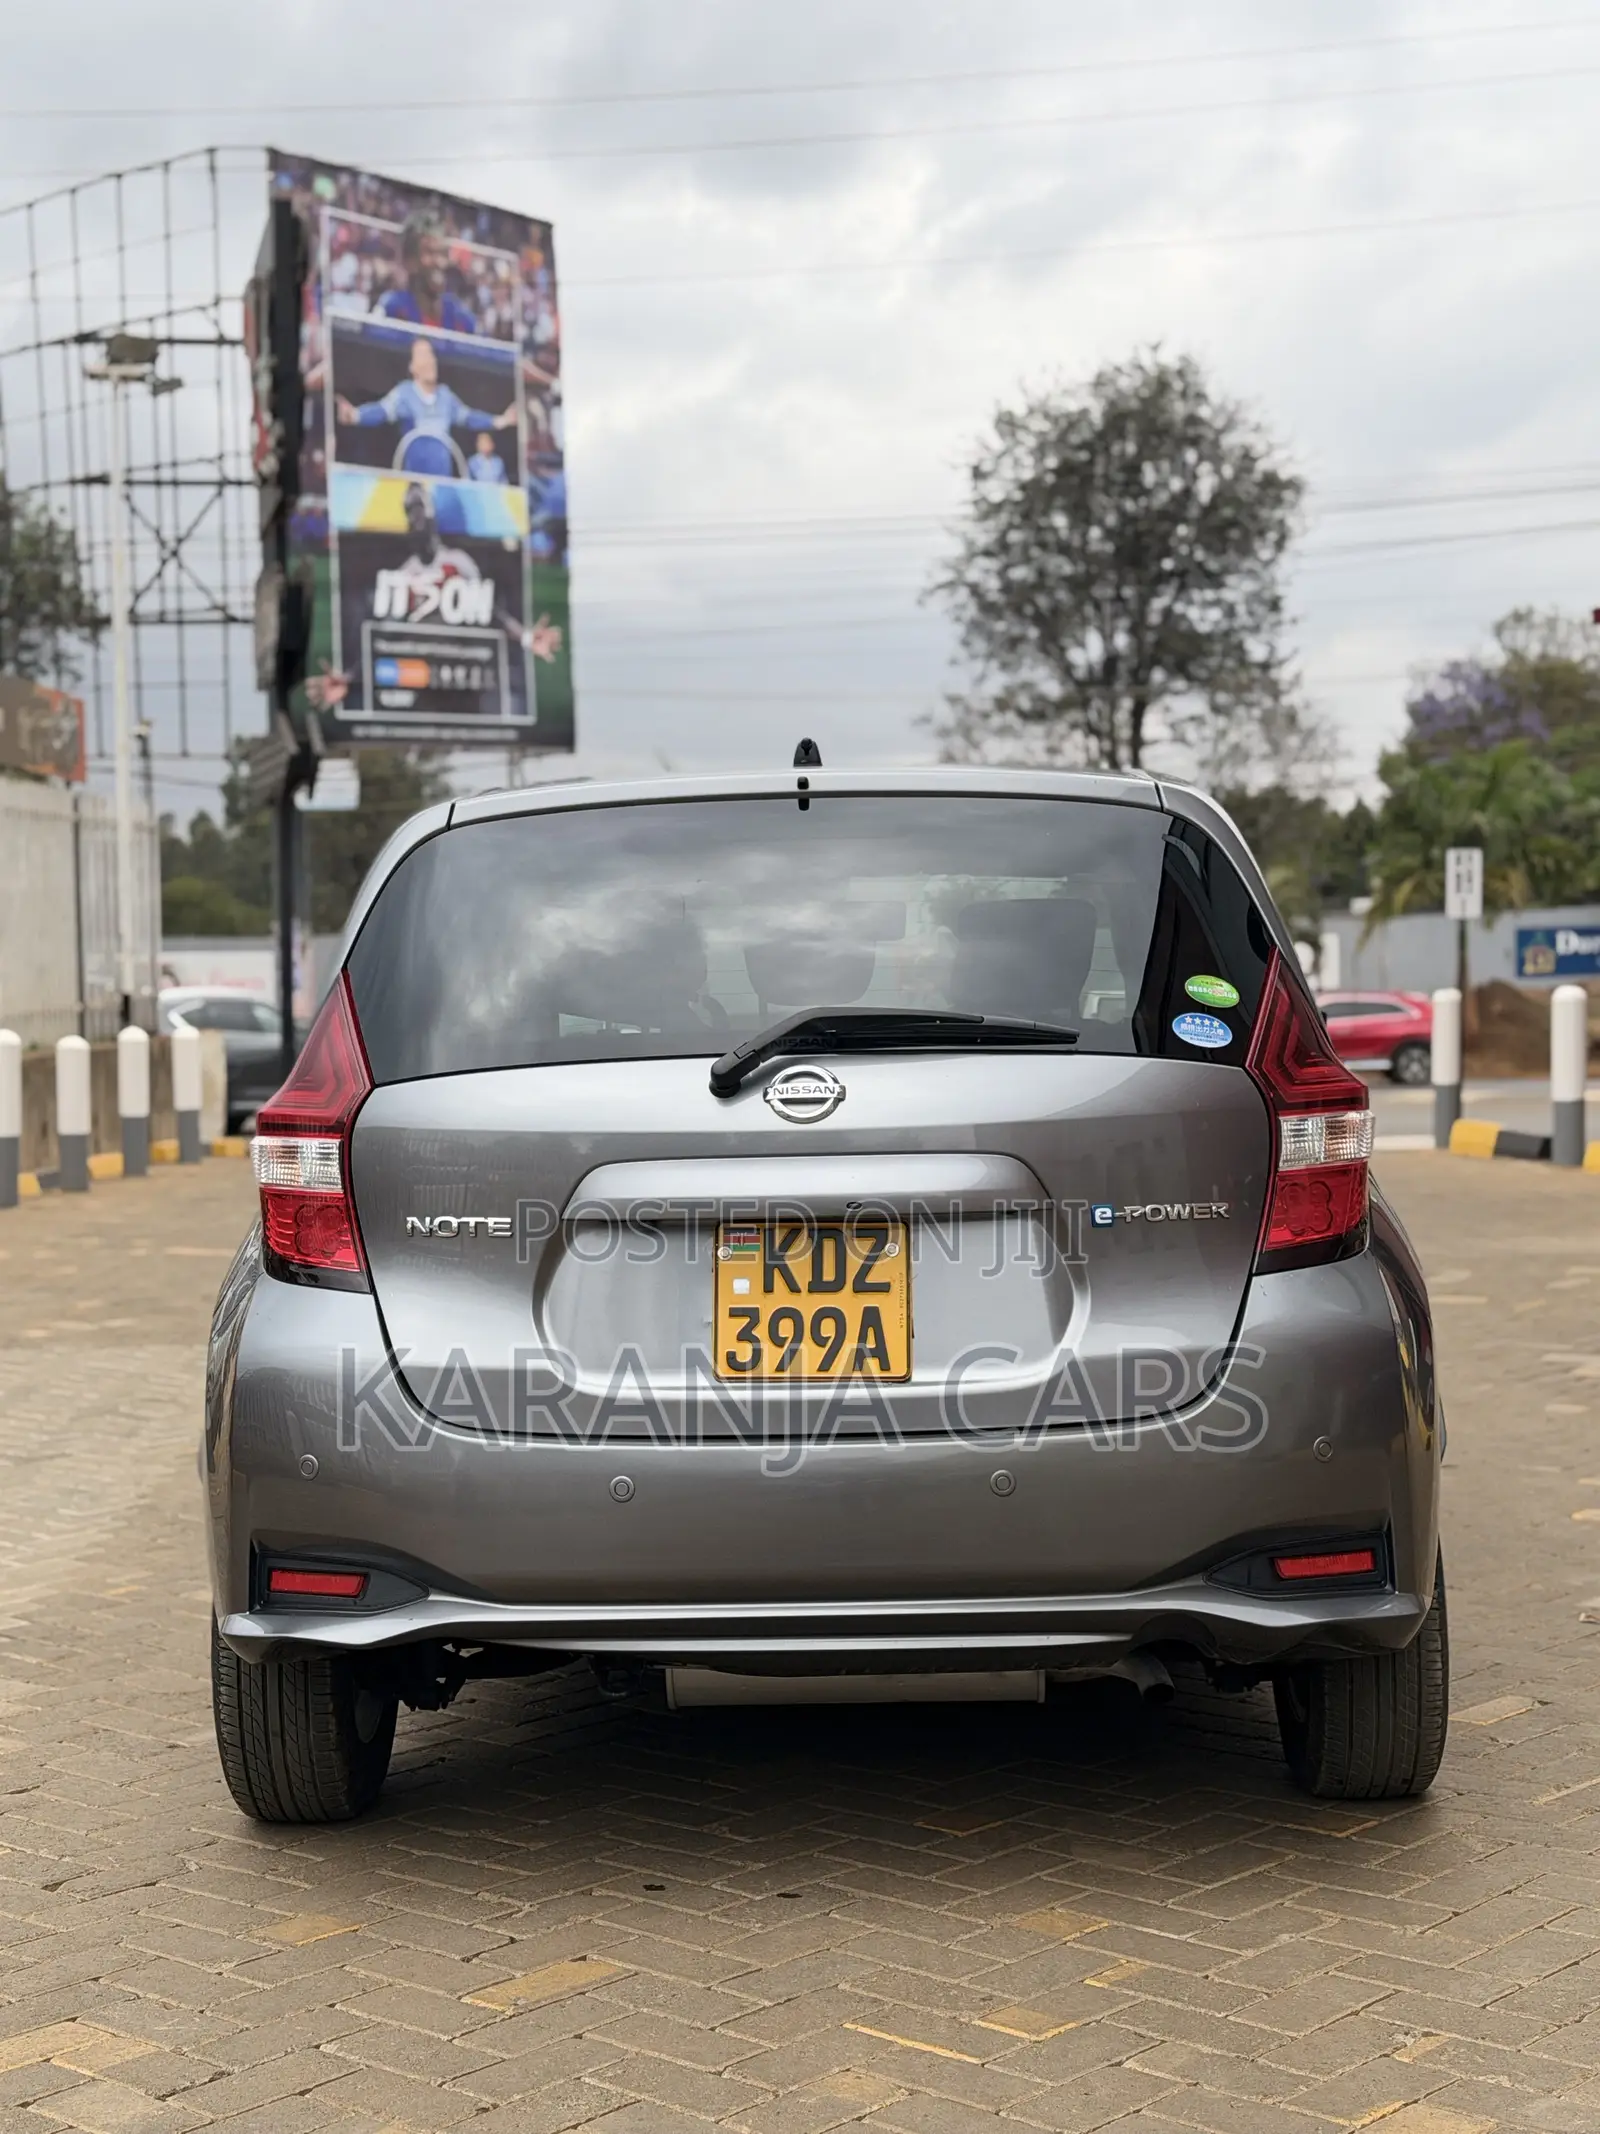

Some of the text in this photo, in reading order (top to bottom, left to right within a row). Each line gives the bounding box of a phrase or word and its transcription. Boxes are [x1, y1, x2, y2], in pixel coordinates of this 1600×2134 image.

[773, 1085, 836, 1096] NISSAN
[1093, 1203, 1230, 1226] e-POWER
[406, 1216, 514, 1237] NOTE
[763, 1228, 892, 1293] KDZ
[726, 1306, 891, 1372] 399A
